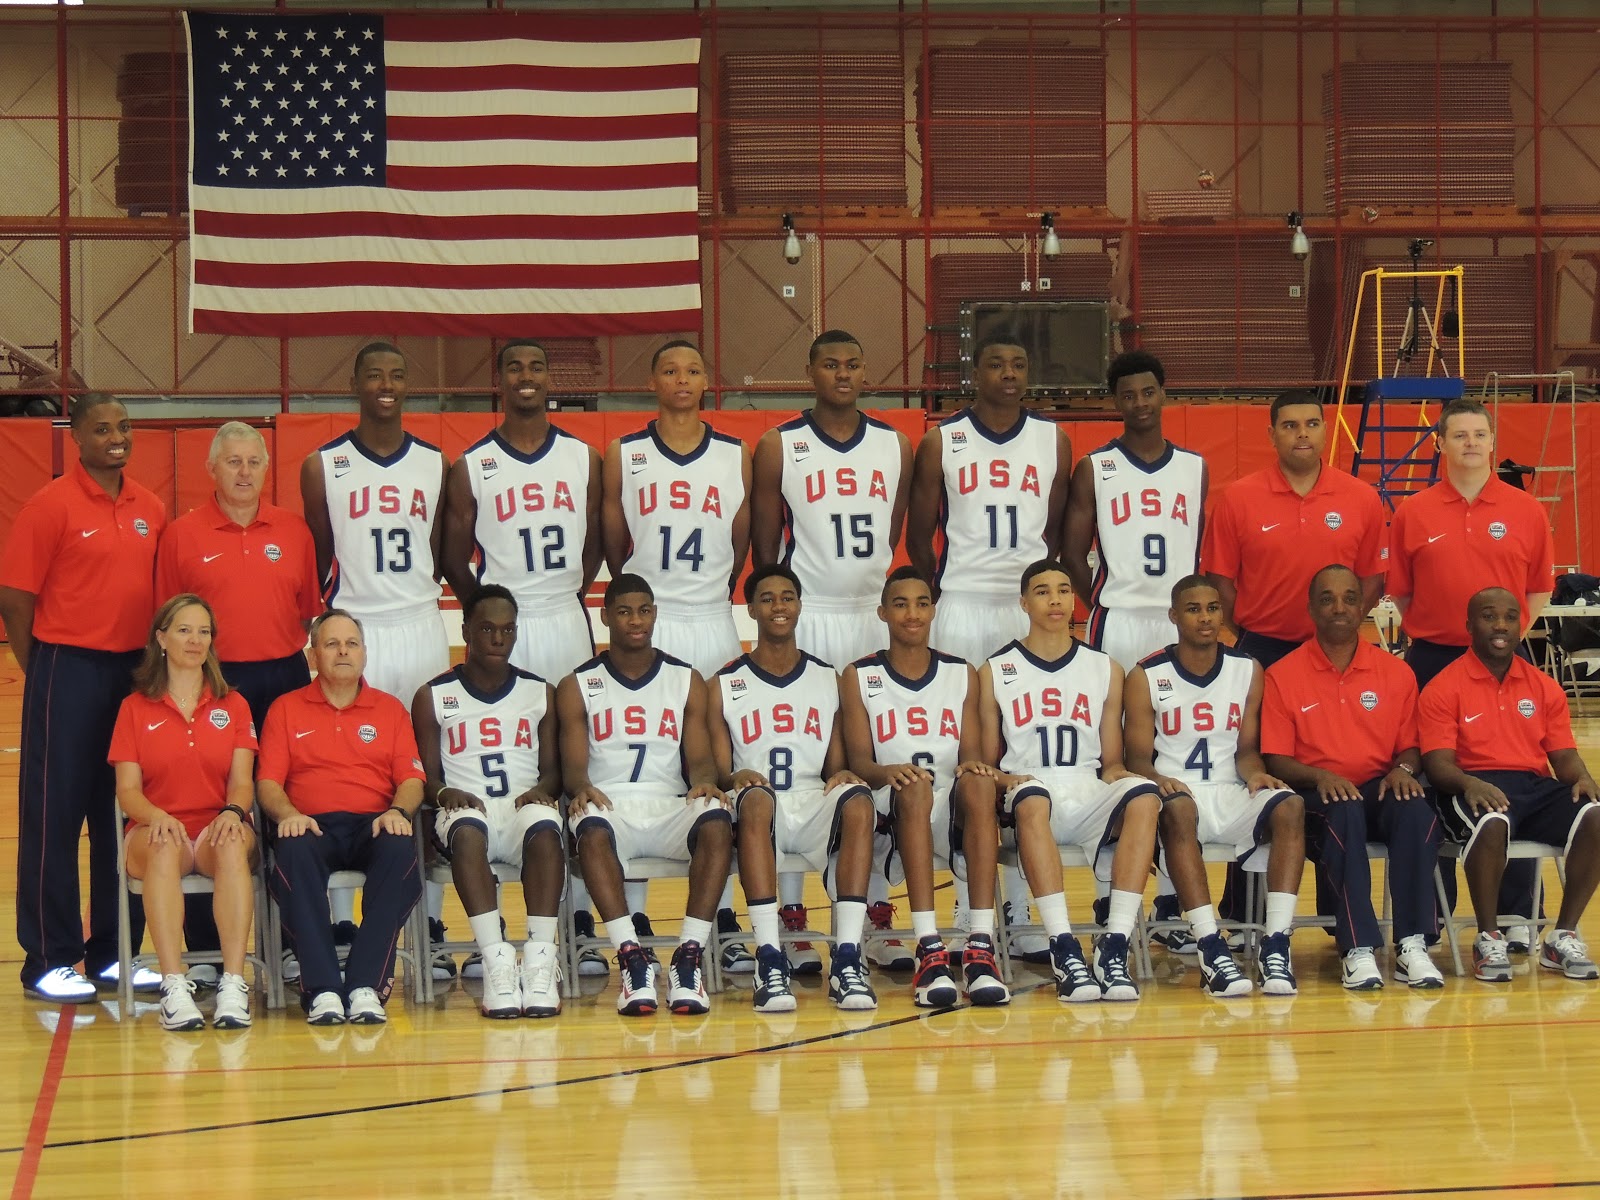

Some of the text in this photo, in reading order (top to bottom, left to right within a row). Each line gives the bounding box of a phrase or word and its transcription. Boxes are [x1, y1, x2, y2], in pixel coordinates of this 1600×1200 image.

[793, 441, 808, 449] USA
[951, 432, 966, 440] USA
[334, 456, 349, 464] USA
[481, 458, 496, 466] USA
[632, 453, 646, 461] USA
[1101, 460, 1115, 468] USA
[806, 468, 888, 503] USA
[959, 460, 1040, 497] USA
[350, 485, 427, 522] USA
[495, 481, 575, 523] USA
[639, 481, 722, 518] USA
[1111, 489, 1188, 526] USA
[831, 514, 874, 559] 15
[986, 505, 1018, 549] 11
[371, 528, 411, 573] 13
[519, 525, 566, 572] 12
[660, 525, 704, 572] 14
[1143, 534, 1166, 576] 9
[587, 678, 603, 686] USA
[730, 679, 746, 687] USA
[867, 676, 882, 684] USA
[1001, 663, 1017, 671] USA
[1157, 679, 1172, 687] USA
[443, 697, 459, 705] USA
[1012, 687, 1092, 727] USA
[1162, 702, 1241, 736] USA
[447, 718, 532, 755] USA
[593, 706, 678, 742] USA
[741, 704, 822, 745] USA
[876, 707, 959, 743] USA
[628, 744, 647, 782] 7
[1036, 725, 1078, 767] 10
[1184, 738, 1213, 781] 4
[480, 753, 510, 798] 5
[769, 747, 793, 791] 8
